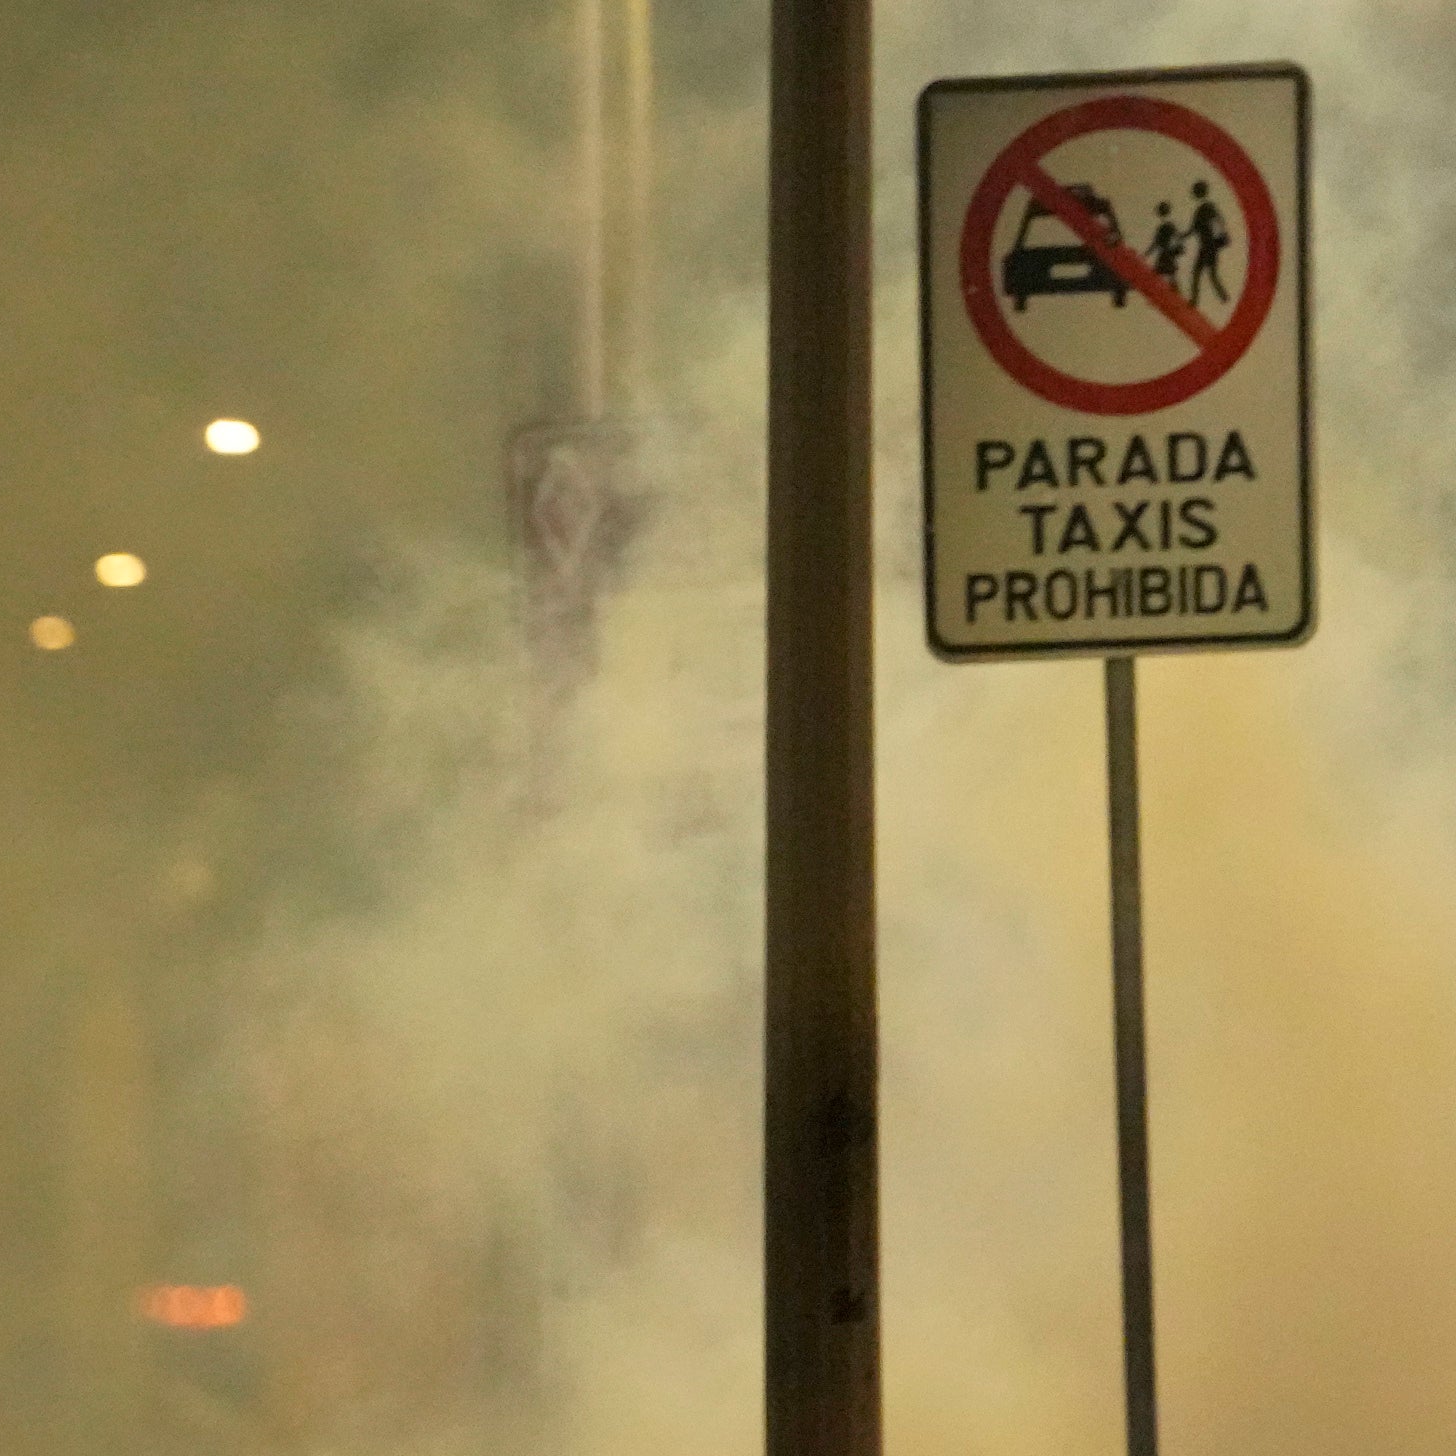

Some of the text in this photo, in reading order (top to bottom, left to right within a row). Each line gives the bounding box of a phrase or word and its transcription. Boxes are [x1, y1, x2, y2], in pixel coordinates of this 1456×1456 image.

[975, 430, 1256, 492] PARADA
[1019, 496, 1219, 555] TAXIS
[965, 562, 1270, 624] PROHIBIDA
